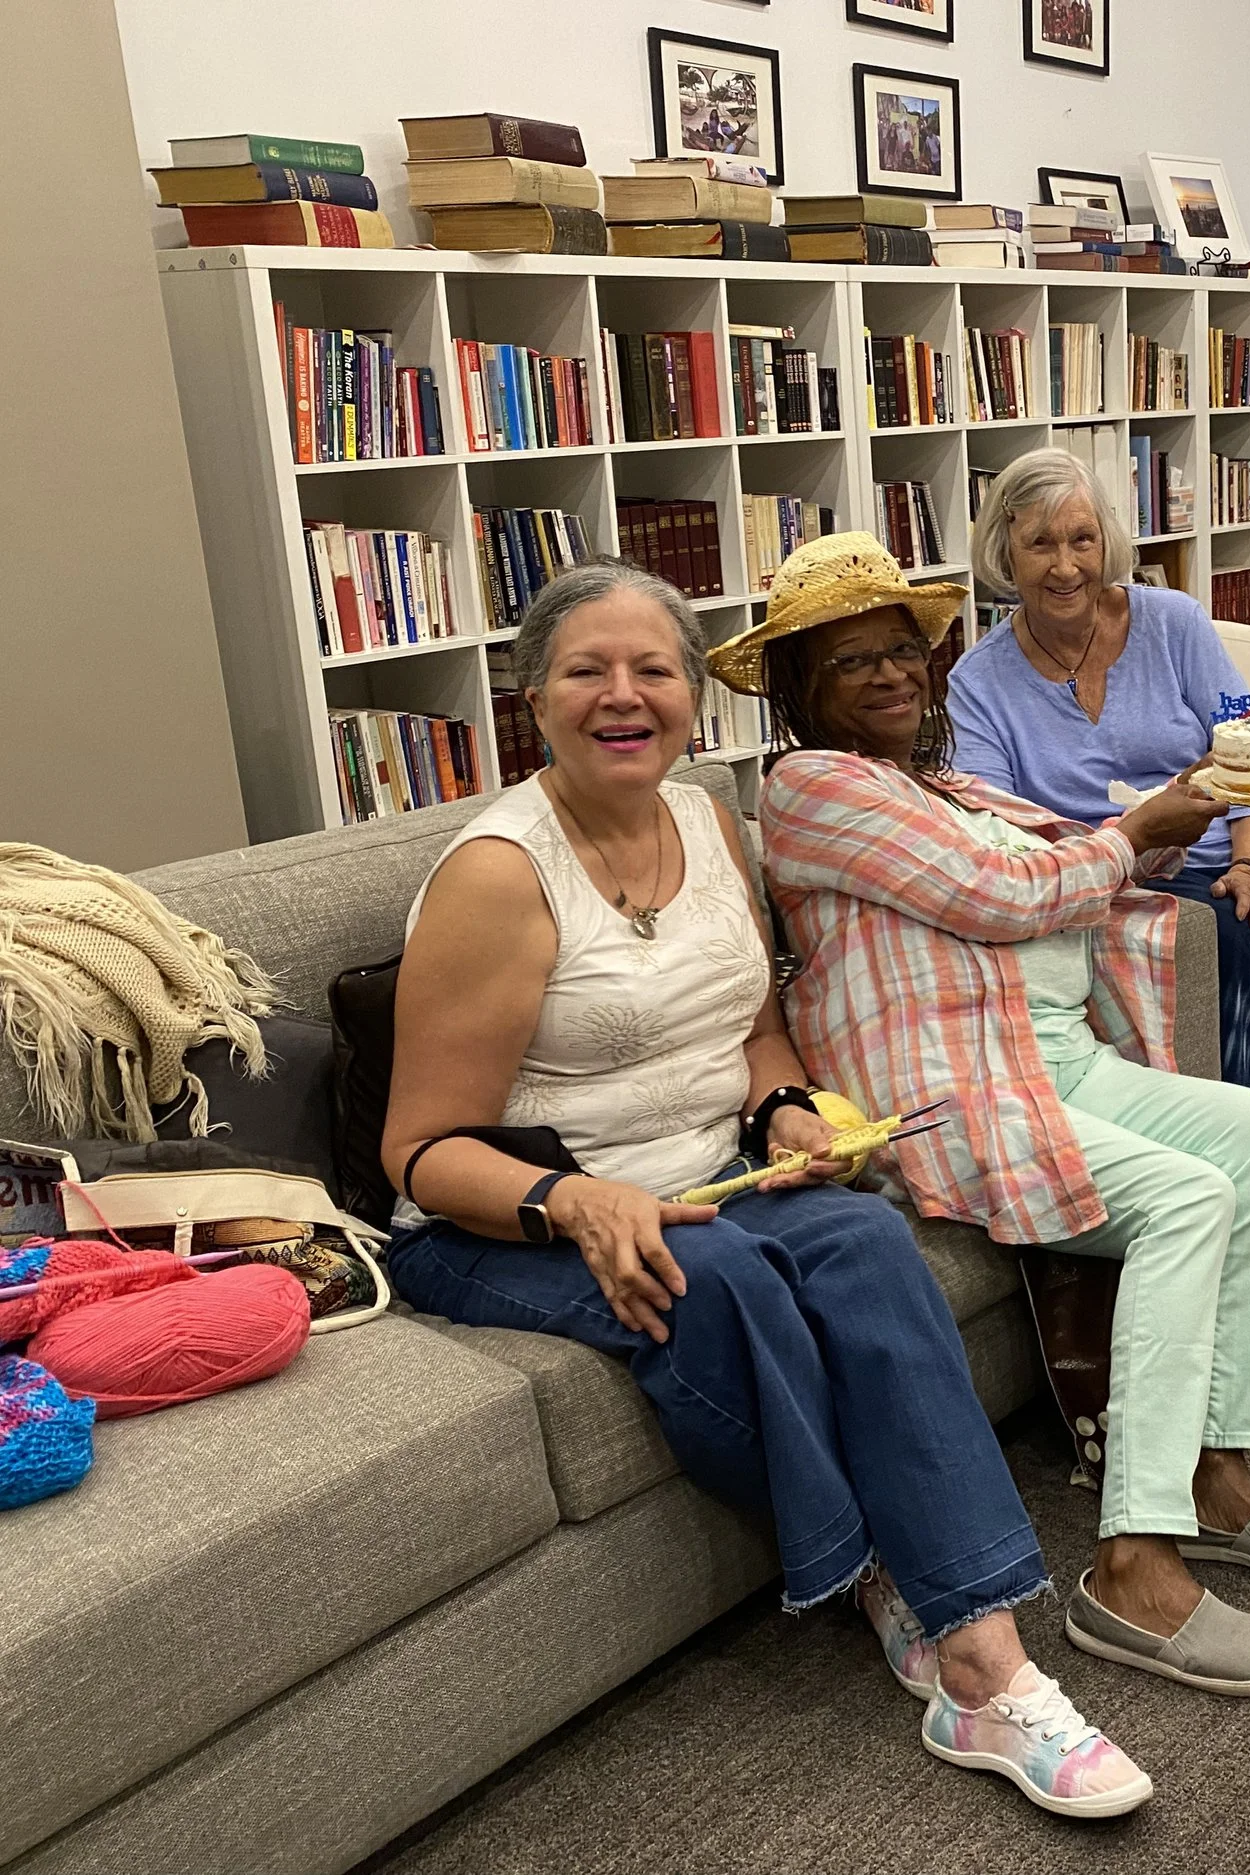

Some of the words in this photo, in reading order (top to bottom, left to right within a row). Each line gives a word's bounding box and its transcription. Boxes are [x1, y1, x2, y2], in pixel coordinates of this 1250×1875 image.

[344, 350, 353, 369] The
[345, 370, 353, 398] Koran
[346, 411, 354, 448] DUMMIES
[315, 598, 324, 620] YOGA
